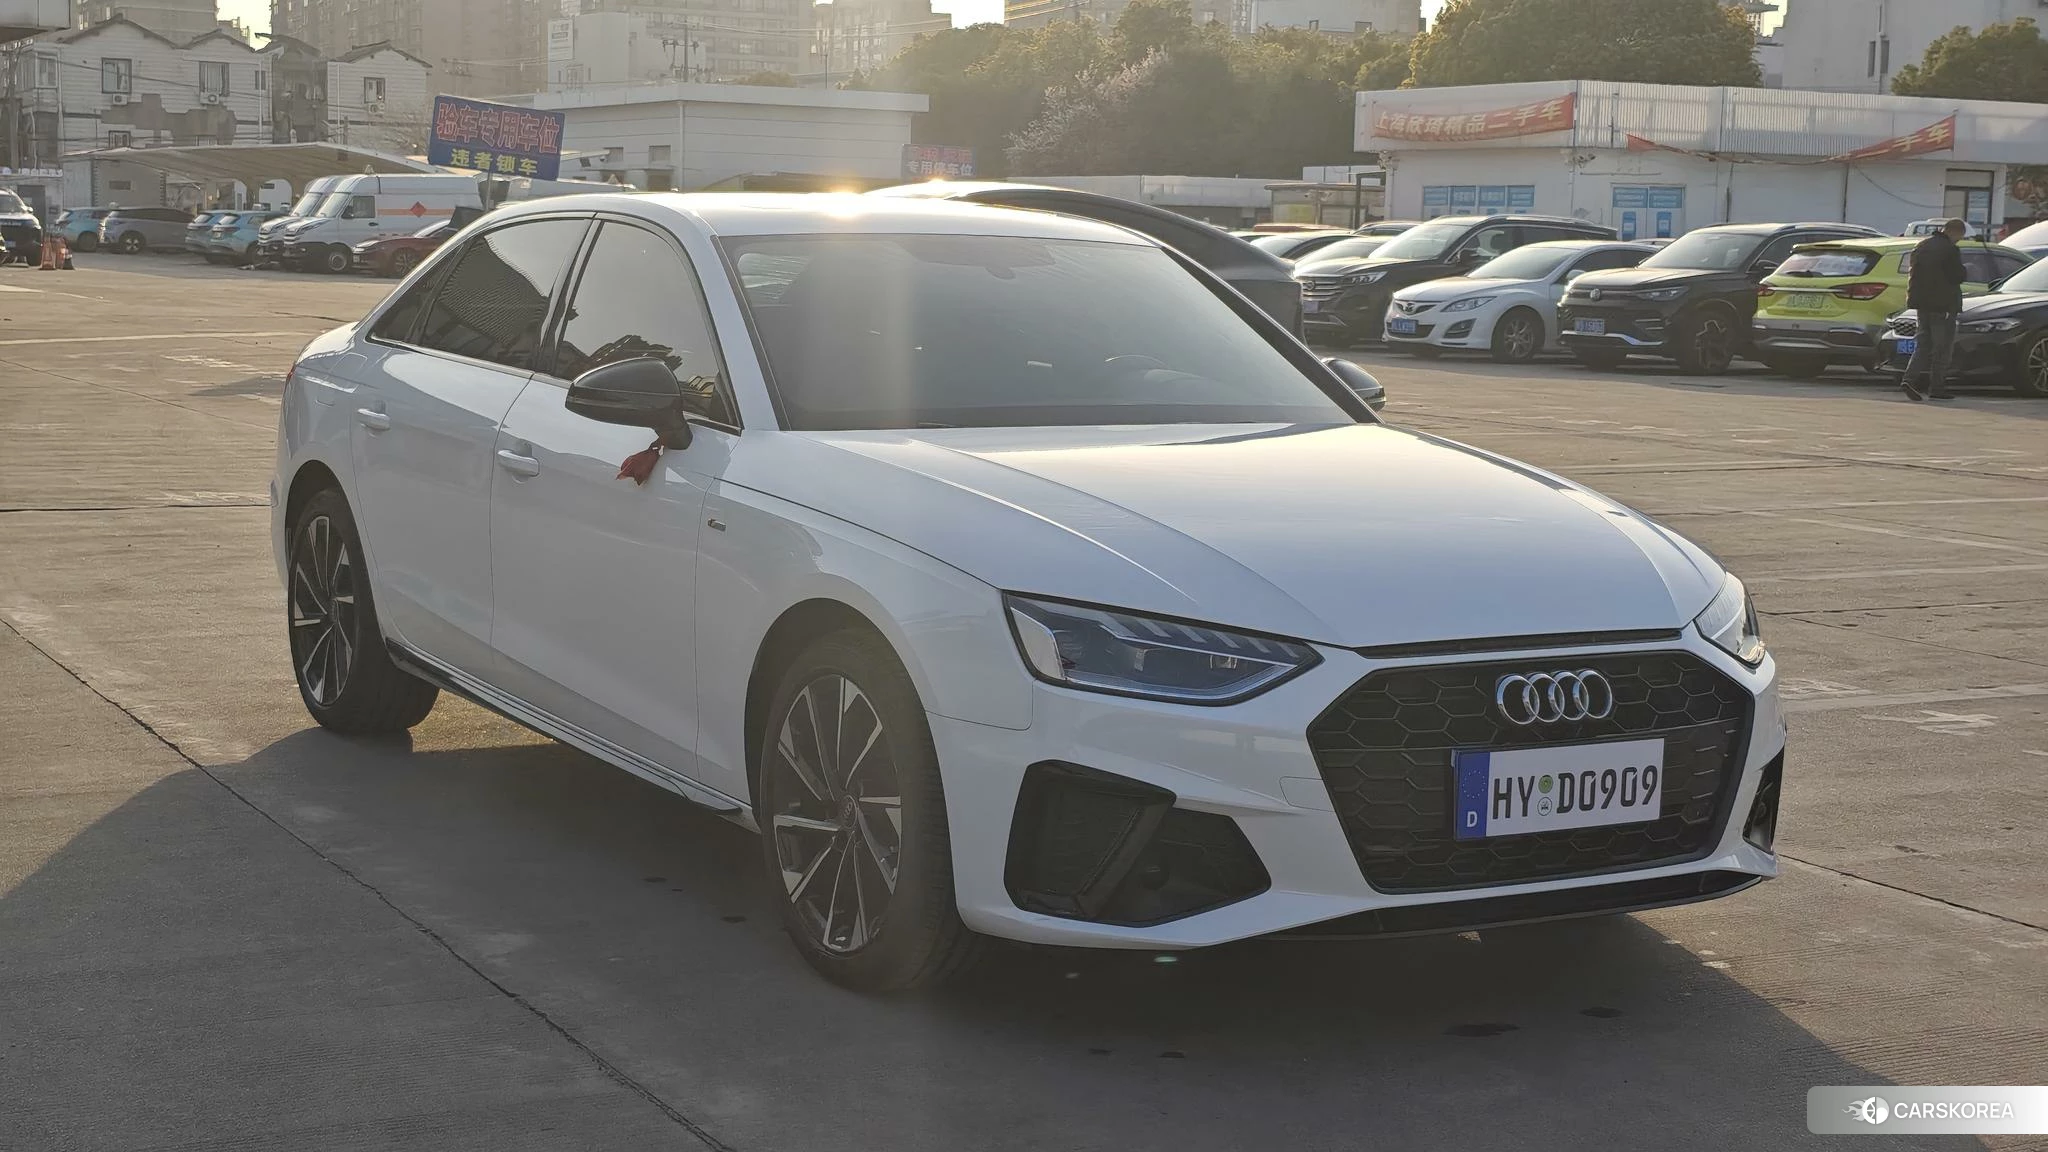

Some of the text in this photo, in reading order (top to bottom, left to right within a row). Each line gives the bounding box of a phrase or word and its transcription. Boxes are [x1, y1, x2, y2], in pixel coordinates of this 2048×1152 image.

[437, 103, 560, 154] 验车专用车位
[450, 148, 538, 175] 违者锁车
[1492, 765, 1659, 820] HY D0909
[1466, 810, 1478, 828] D
